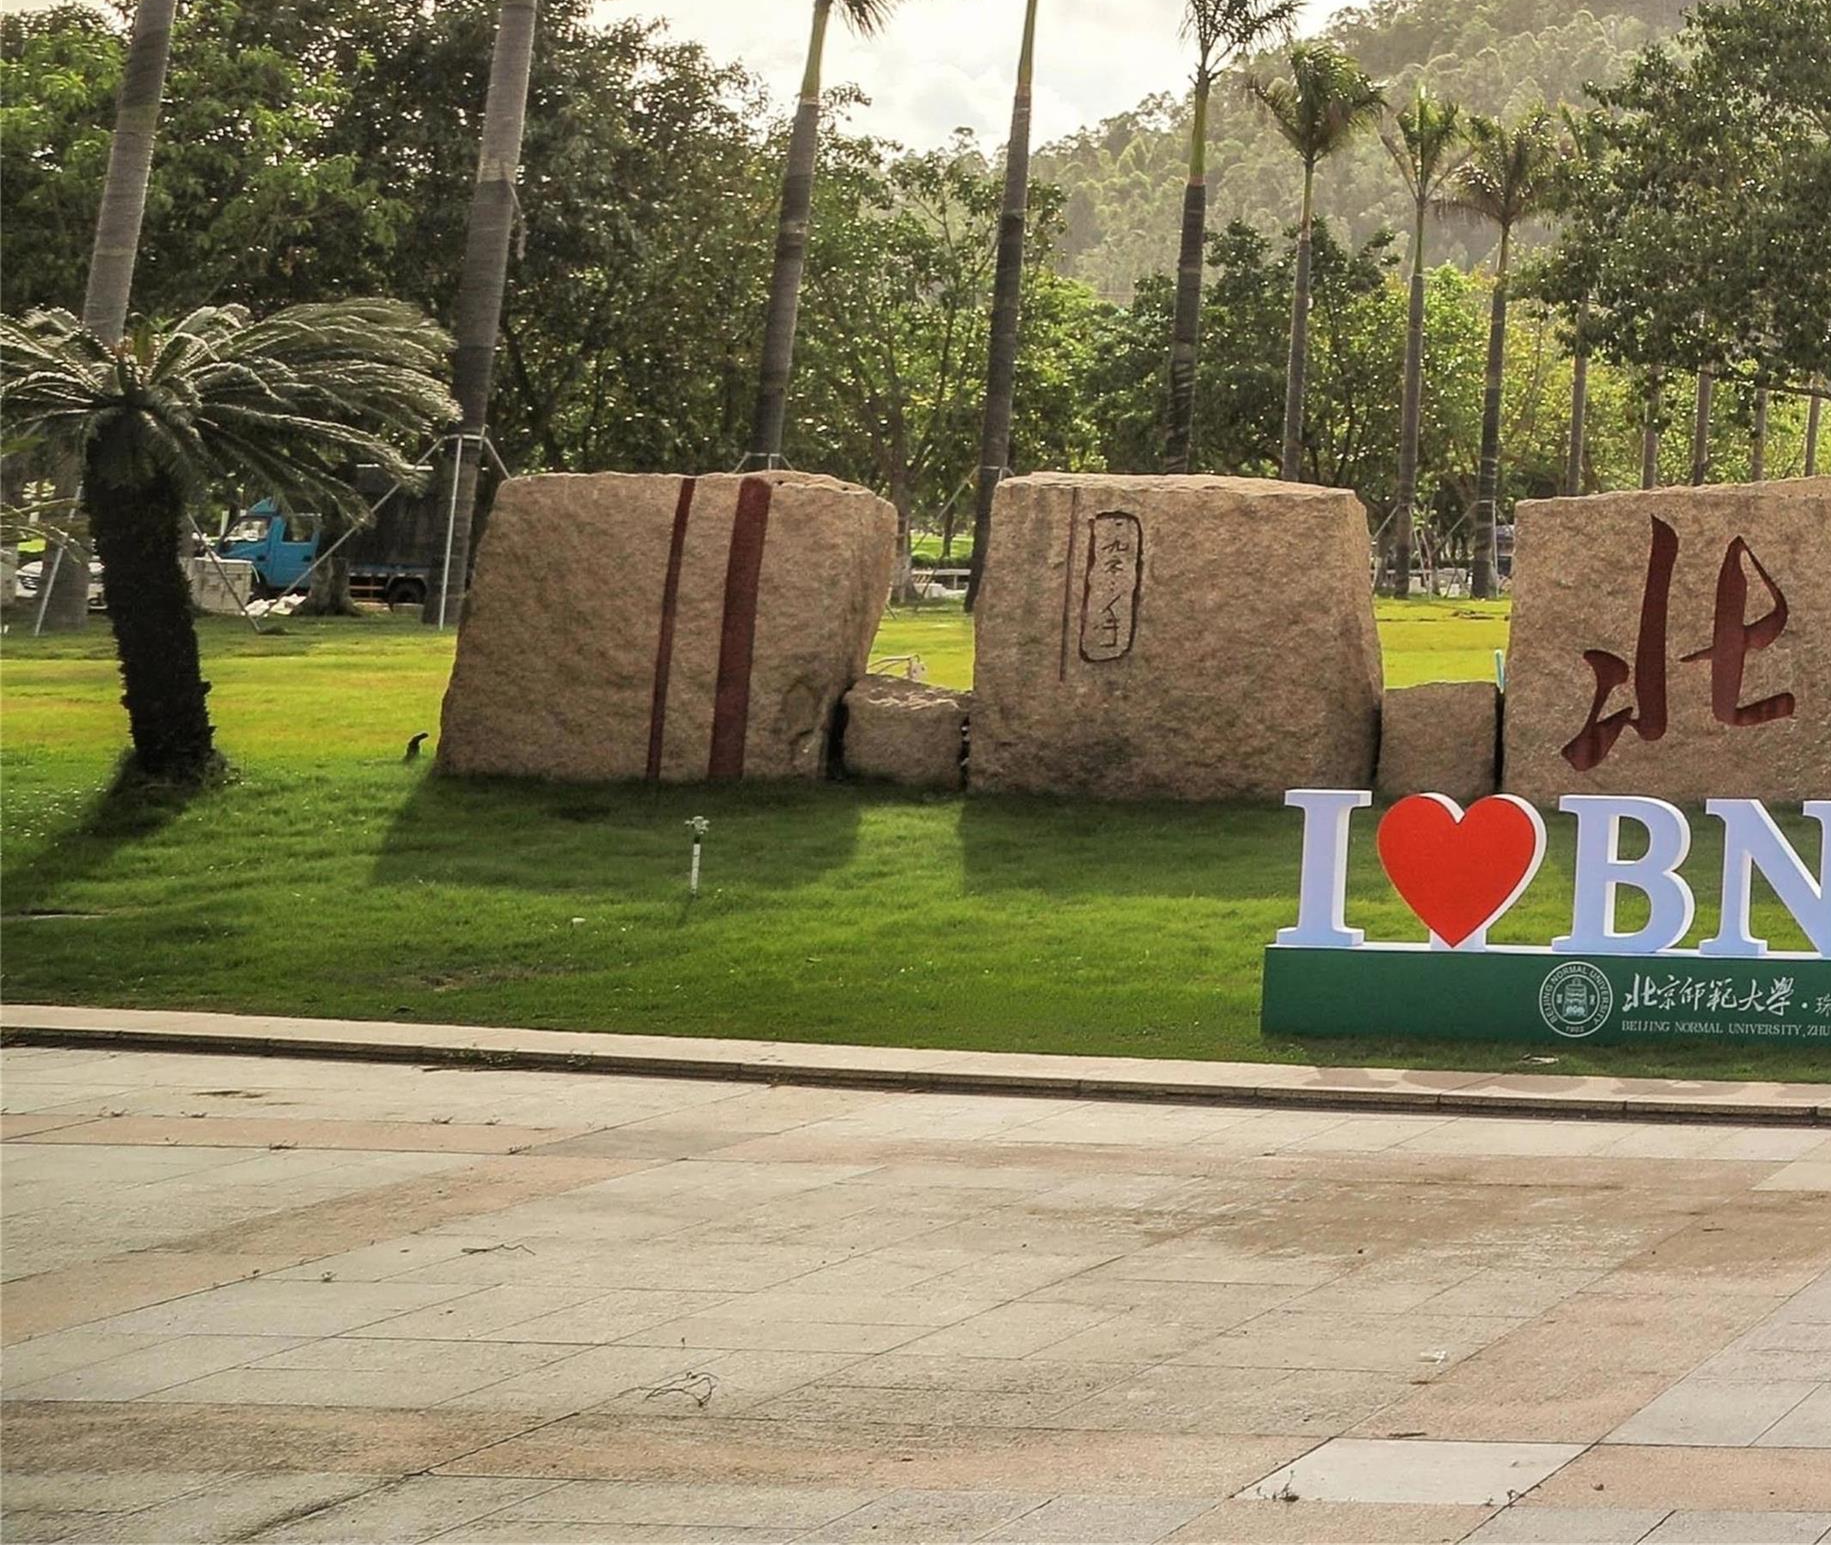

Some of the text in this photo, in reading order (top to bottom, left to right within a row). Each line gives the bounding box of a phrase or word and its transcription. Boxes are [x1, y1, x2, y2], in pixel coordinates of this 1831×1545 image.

[1561, 514, 1797, 772] 北
[1275, 789, 1373, 948] I
[1621, 1020, 1670, 1032] BEIJING
[1674, 1021, 1723, 1034] NORMAL
[1807, 1025, 1831, 1037] ZHU
